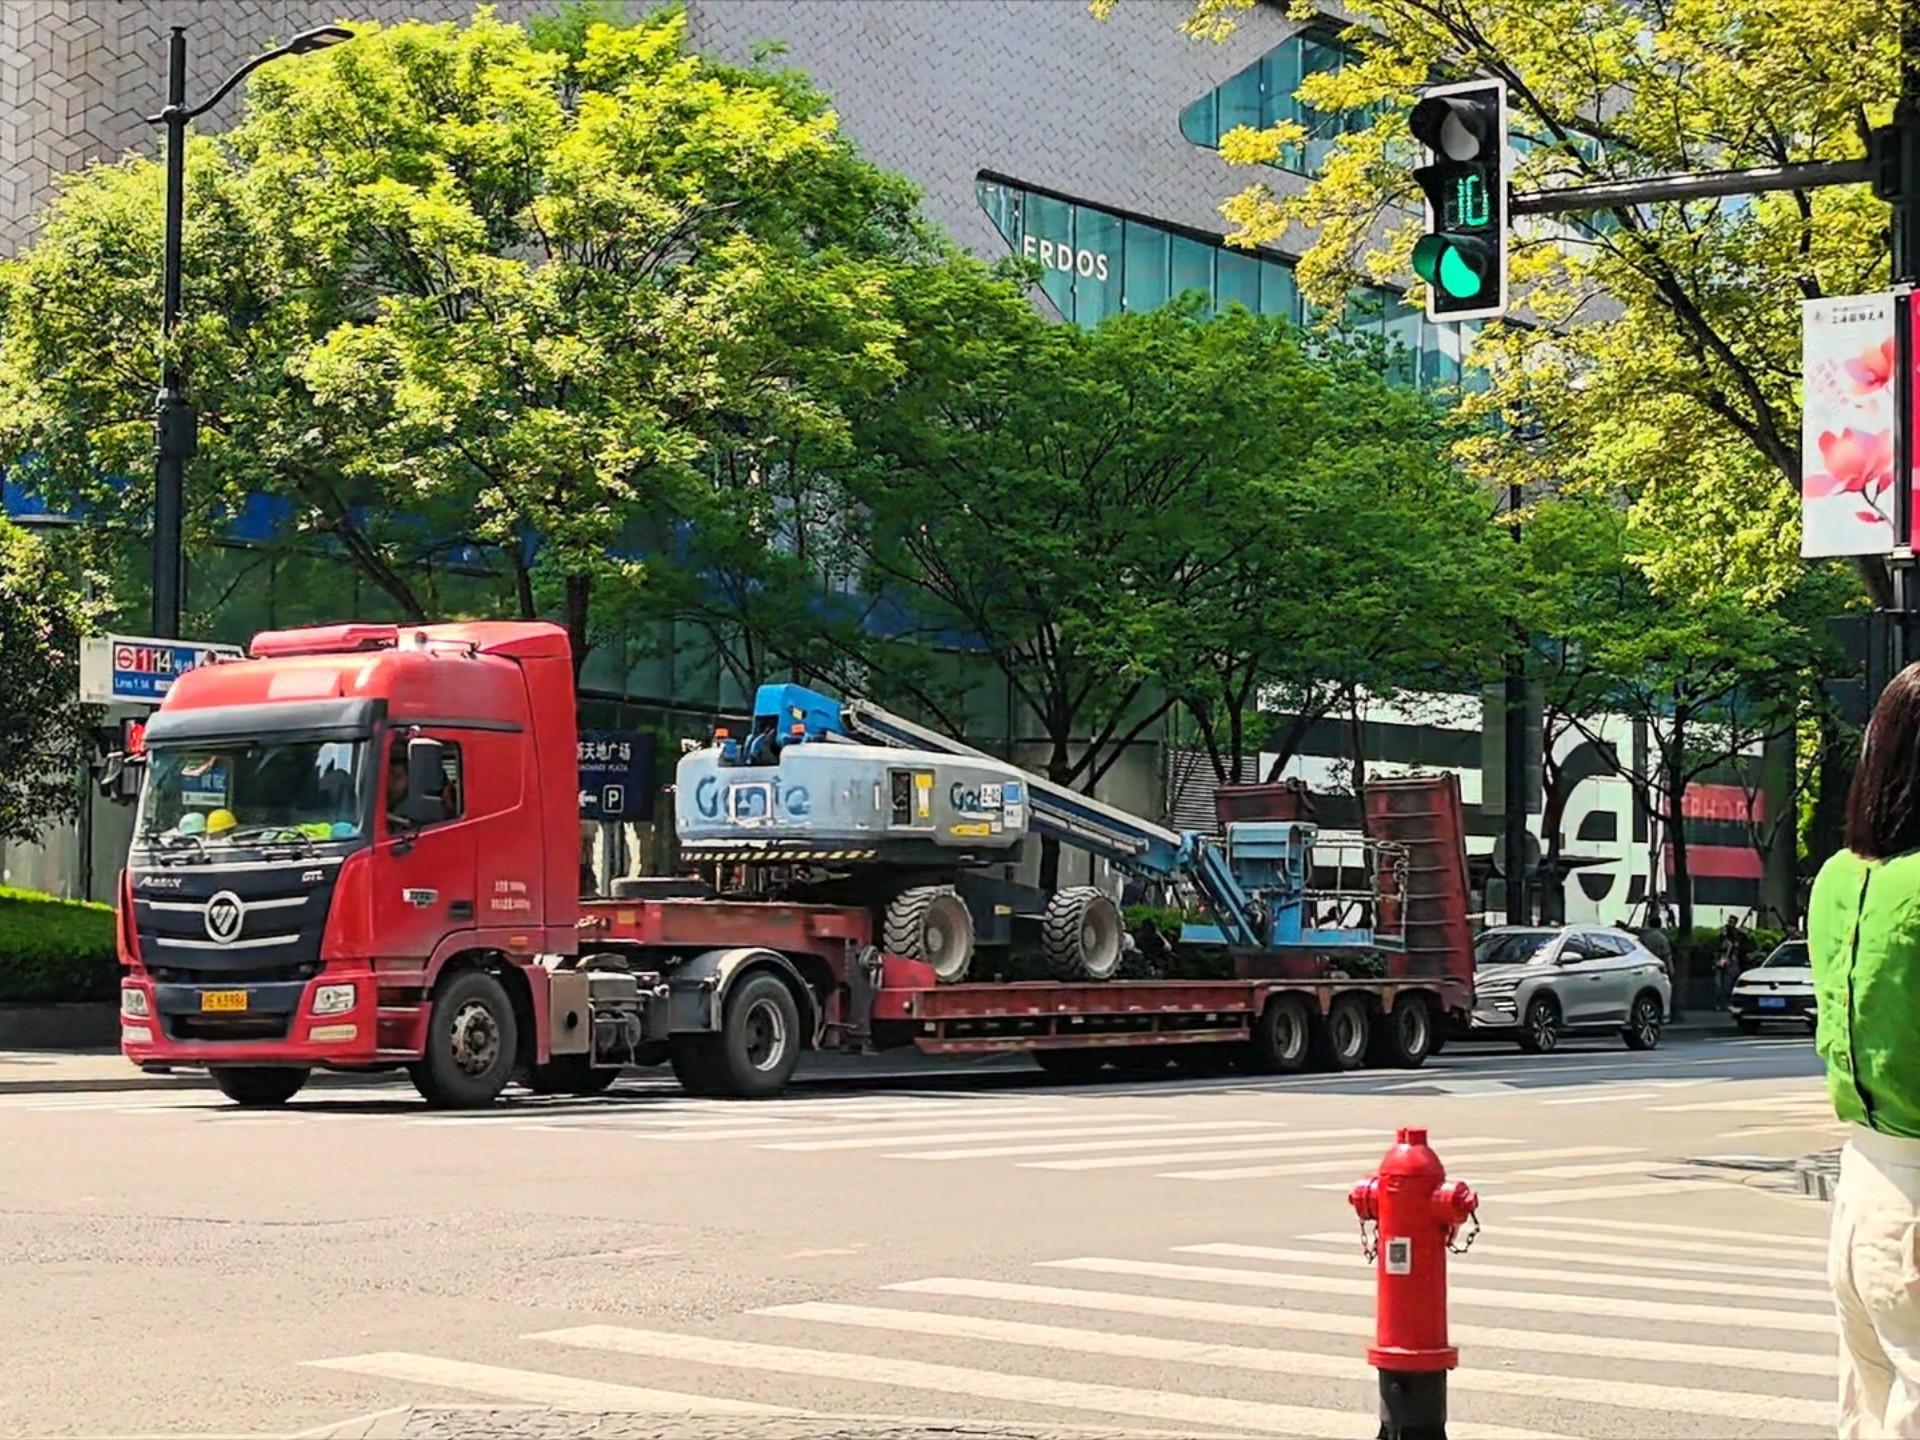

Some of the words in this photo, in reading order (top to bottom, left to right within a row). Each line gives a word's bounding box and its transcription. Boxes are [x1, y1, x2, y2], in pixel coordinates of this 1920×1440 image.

[1457, 174, 1489, 226] 10
[1023, 234, 1108, 282] ERDOS
[608, 790, 619, 808] P
